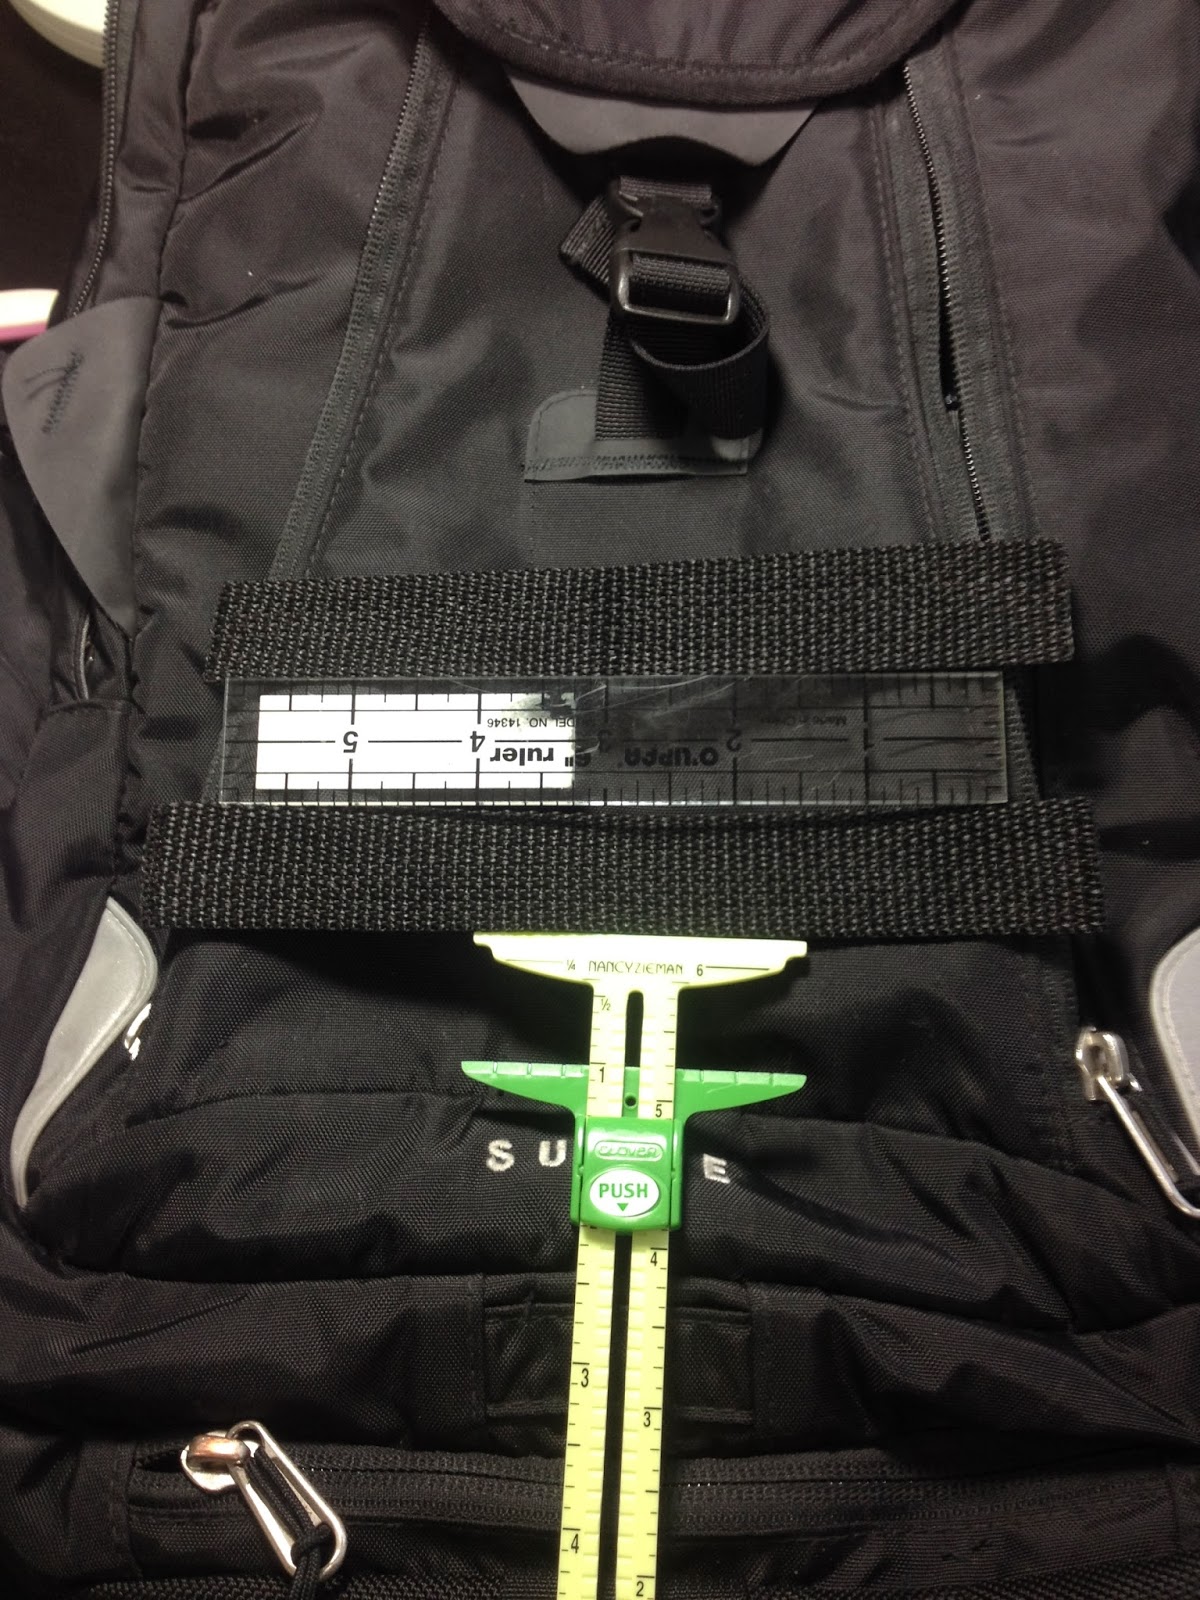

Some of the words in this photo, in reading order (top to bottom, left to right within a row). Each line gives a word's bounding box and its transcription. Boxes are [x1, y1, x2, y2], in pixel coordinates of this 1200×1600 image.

[486, 717, 521, 728] 14346
[526, 717, 548, 728] NO.
[555, 717, 576, 728] DEL
[343, 730, 359, 753] 5
[470, 730, 486, 753] 4
[725, 729, 742, 752] 2
[490, 746, 555, 766] ruler
[696, 963, 704, 977] 6
[598, 1067, 606, 1083] 1
[655, 1103, 663, 1118] 5
[598, 1182, 649, 1199] PUSH
[650, 1252, 658, 1267] 4
[580, 1368, 590, 1388] 3
[643, 1411, 651, 1428] 3
[570, 1533, 580, 1554] 4
[635, 1581, 645, 1598] 2
